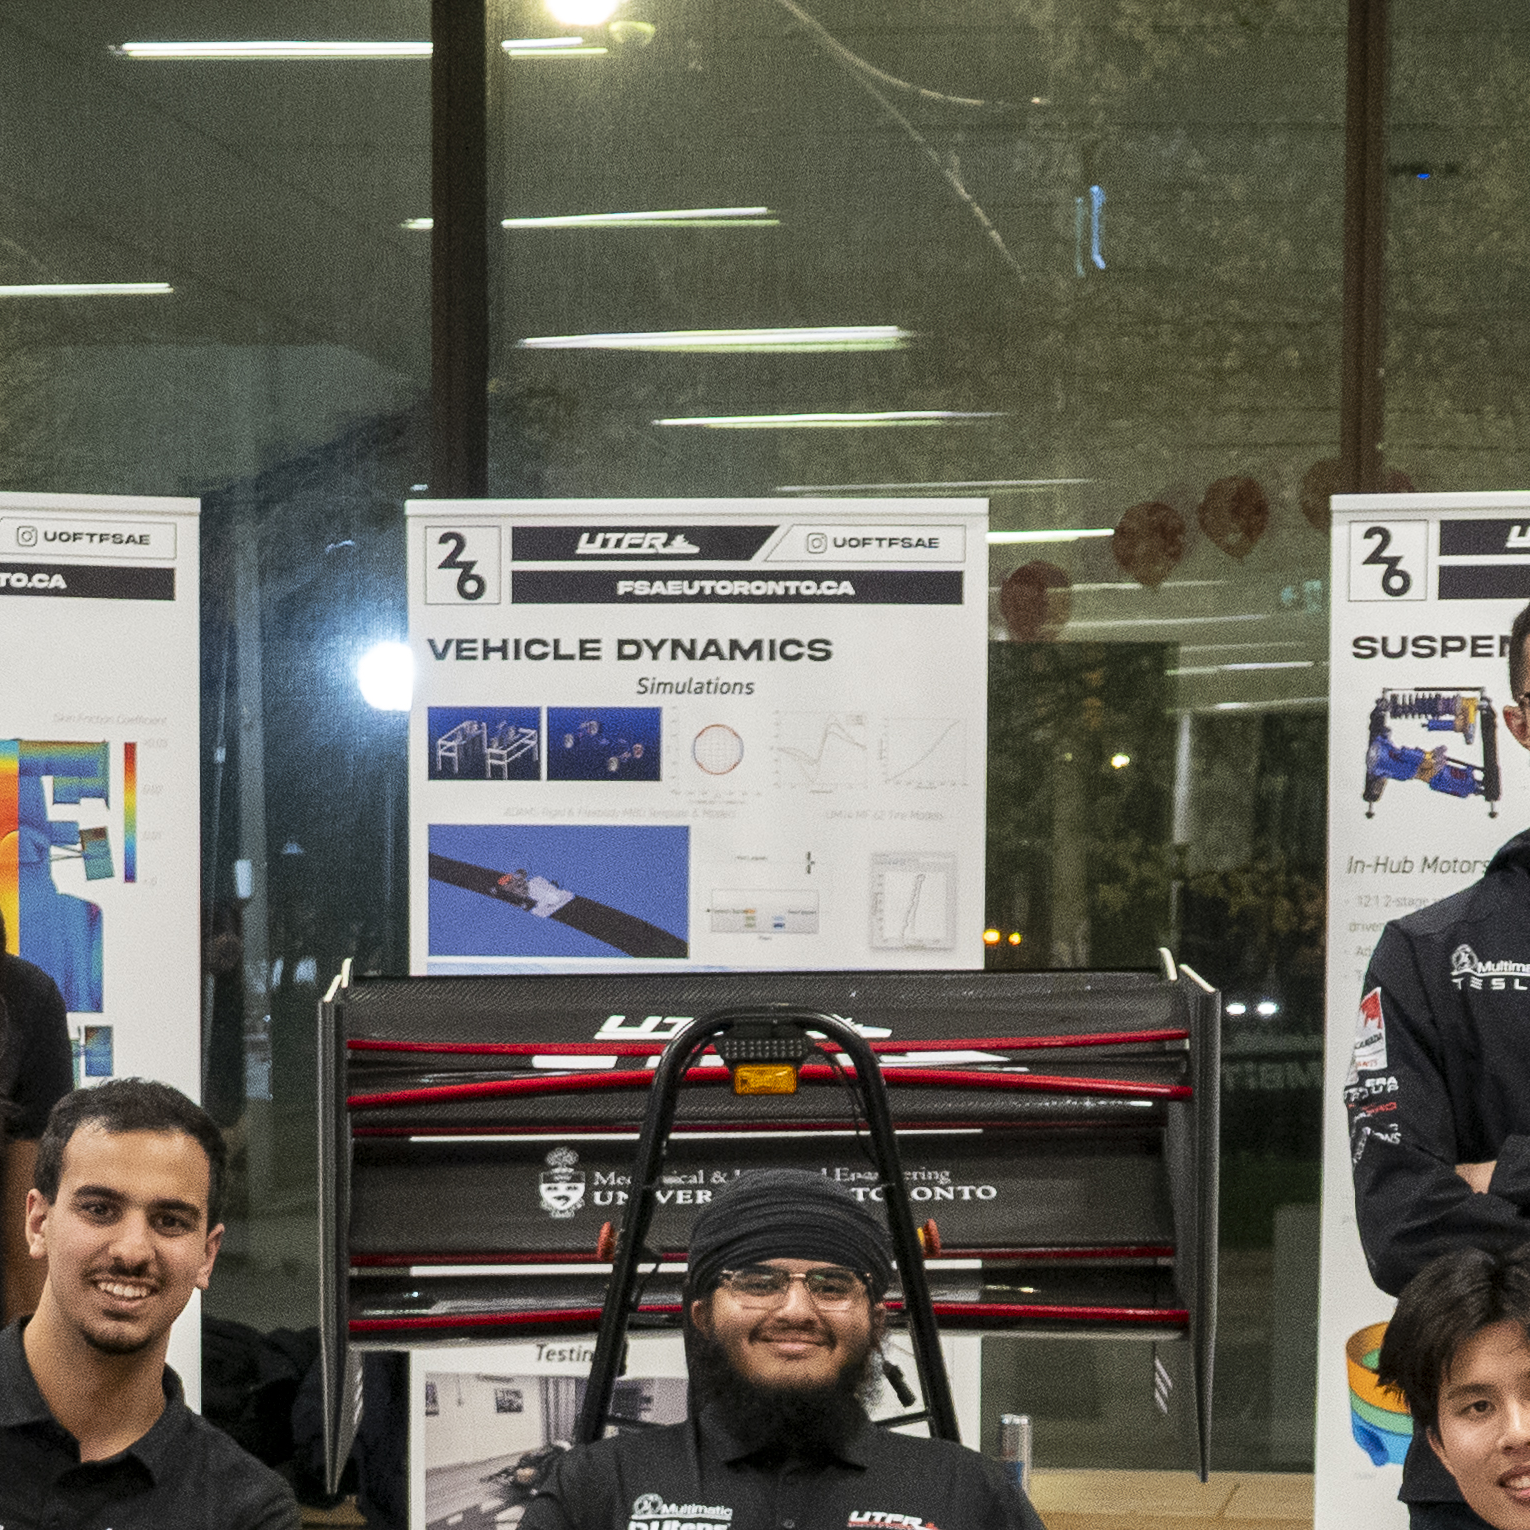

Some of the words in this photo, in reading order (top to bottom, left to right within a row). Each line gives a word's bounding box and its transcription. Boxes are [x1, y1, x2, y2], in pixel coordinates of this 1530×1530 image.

[43, 530, 152, 546] UOFTFSAE
[832, 536, 941, 550] UOFTFSAE
[616, 579, 856, 597] FSAEUTORONTO.CA
[427, 637, 603, 662] VEHICLE
[616, 637, 835, 663] DYNAMICS
[635, 675, 756, 697] Simulations
[1347, 855, 1414, 875] In-Hub
[851, 1185, 998, 1202] TOONTO
